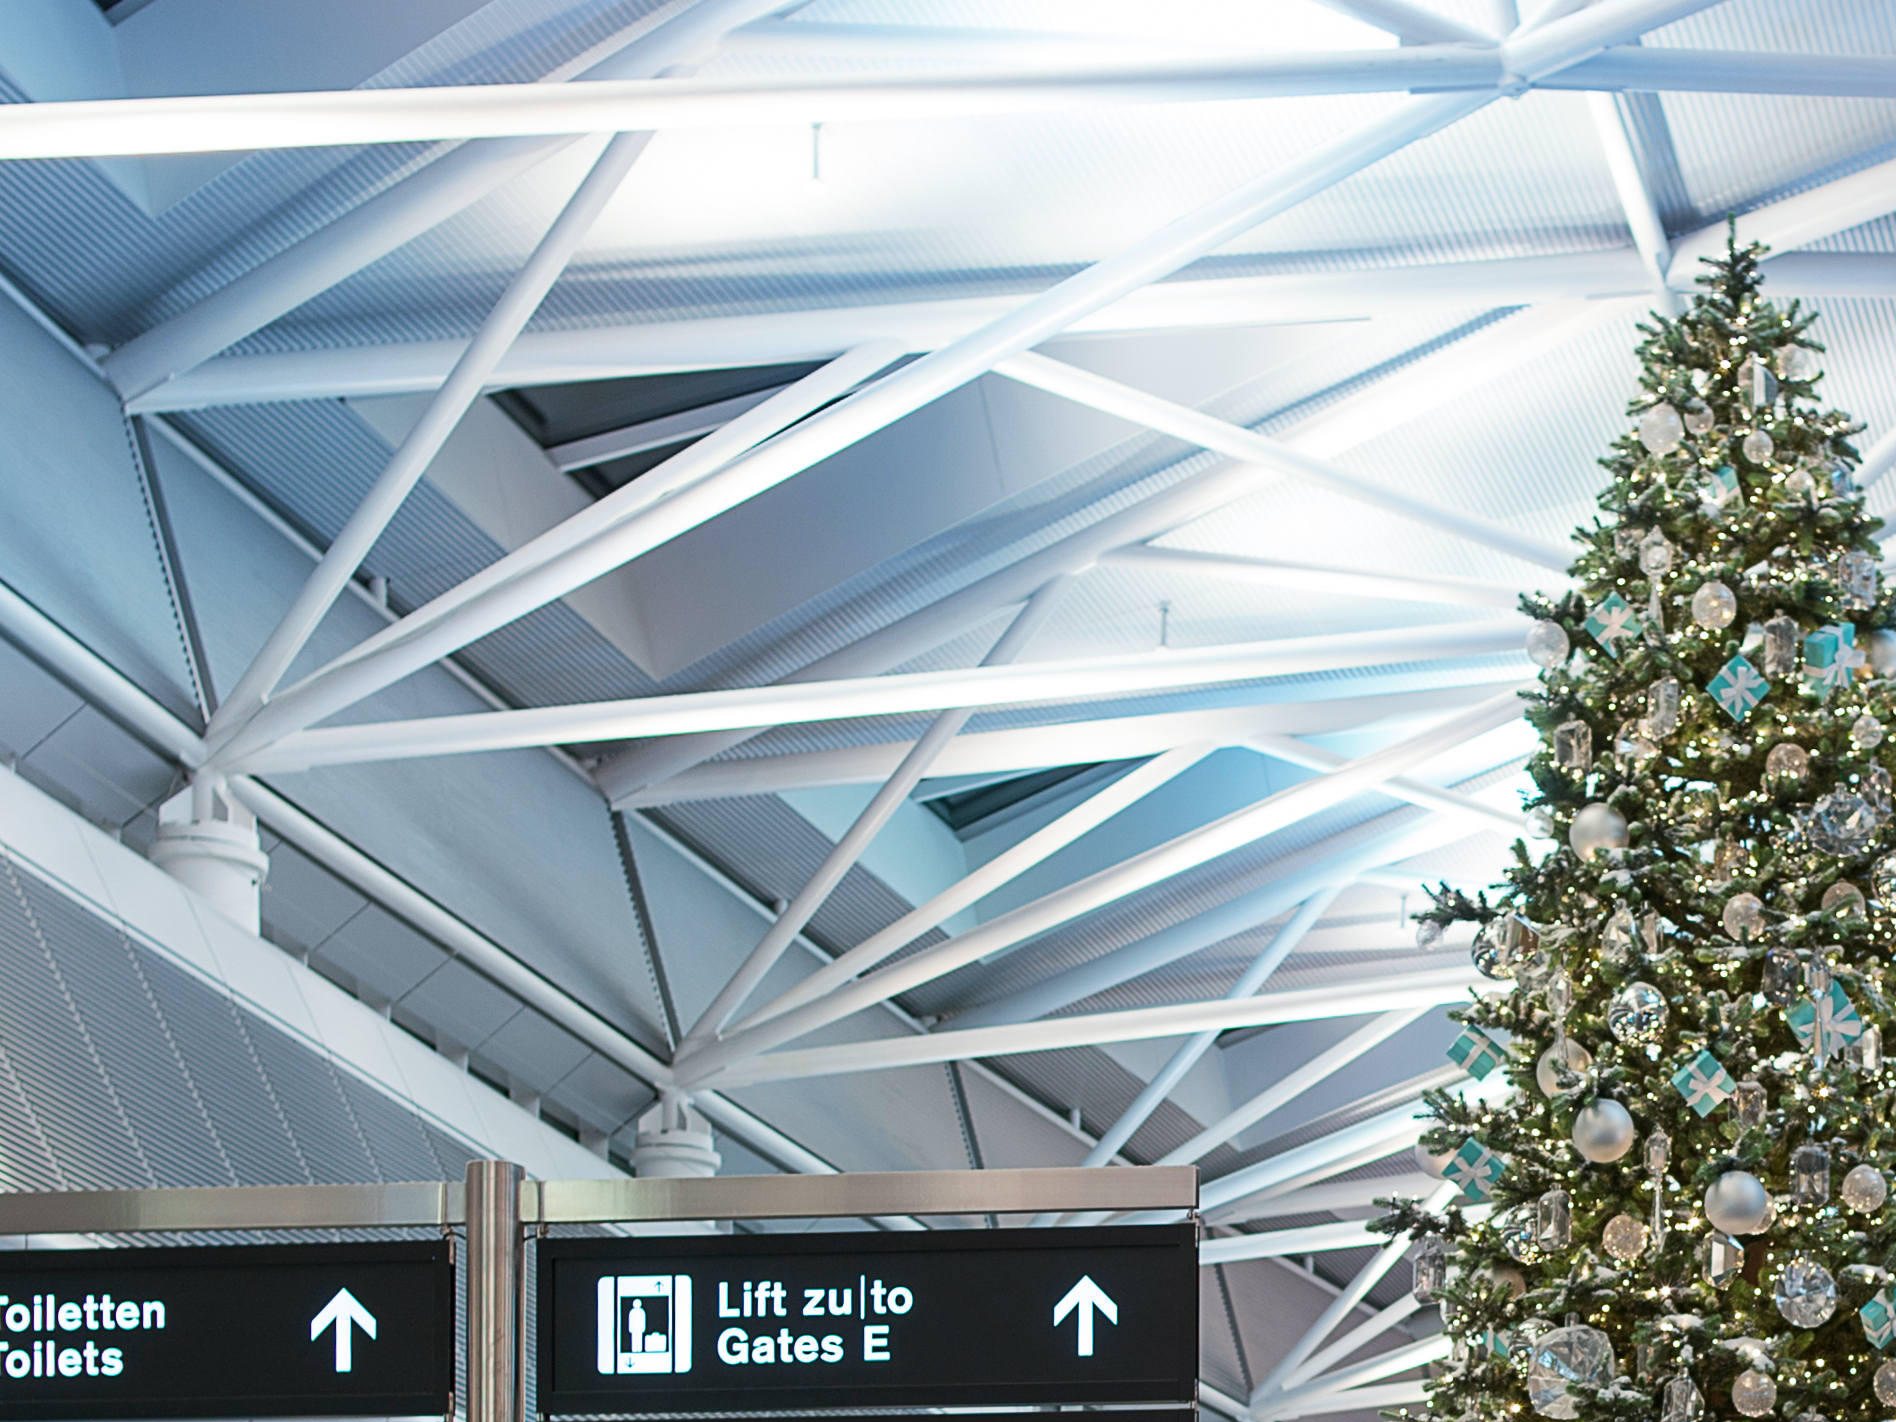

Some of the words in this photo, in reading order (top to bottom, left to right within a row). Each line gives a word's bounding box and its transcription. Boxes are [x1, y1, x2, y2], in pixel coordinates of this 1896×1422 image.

[718, 1281, 787, 1318] Lift
[717, 1327, 844, 1365] Gates
[862, 1325, 891, 1362] E
